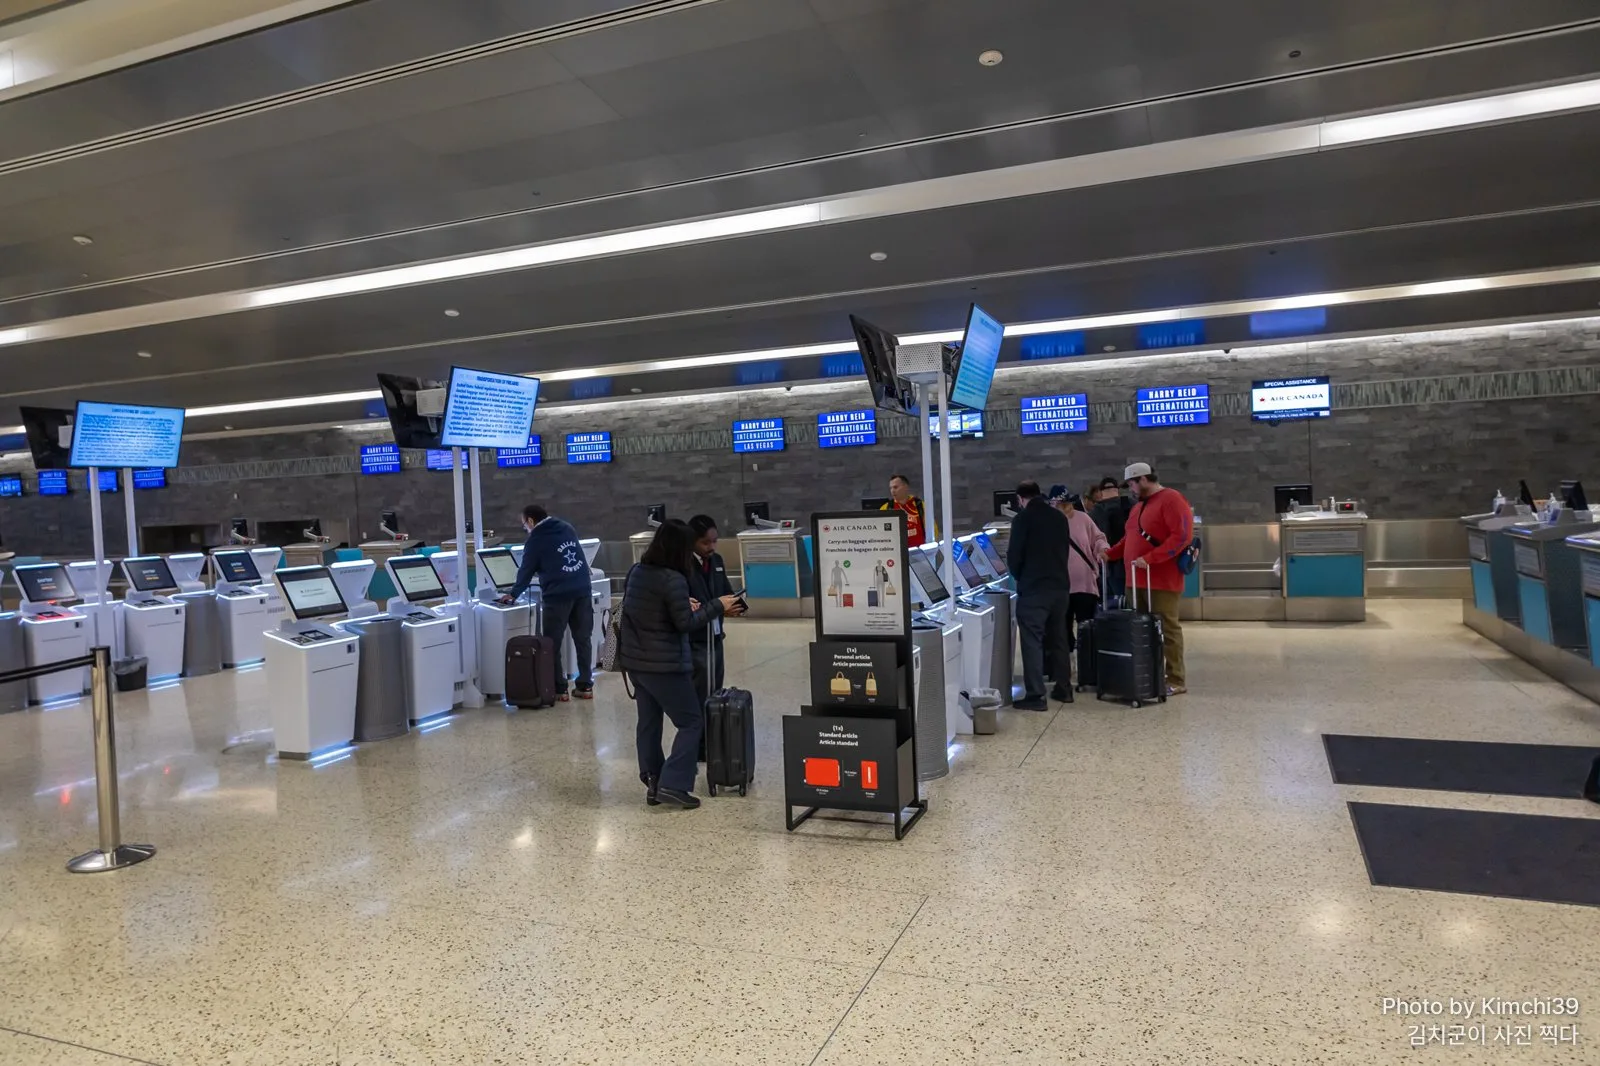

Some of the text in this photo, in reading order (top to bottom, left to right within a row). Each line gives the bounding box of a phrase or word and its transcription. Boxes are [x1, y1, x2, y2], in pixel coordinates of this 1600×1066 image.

[1149, 388, 1196, 399] HARRY REID
[1032, 397, 1075, 408] HARRY REID
[1142, 400, 1205, 412] INTERNATIONAL
[827, 414, 847, 422] HARRY
[1026, 410, 1084, 420] INTERNATIONAL
[1152, 414, 1194, 424] LAS VEGAS
[822, 424, 872, 434] INTERNATIONAL
[1035, 422, 1074, 431] LAS VEGAS
[737, 432, 780, 440] INTERNATIONAL
[557, 541, 576, 552] DALLAS
[562, 560, 583, 572] COWBOYS
